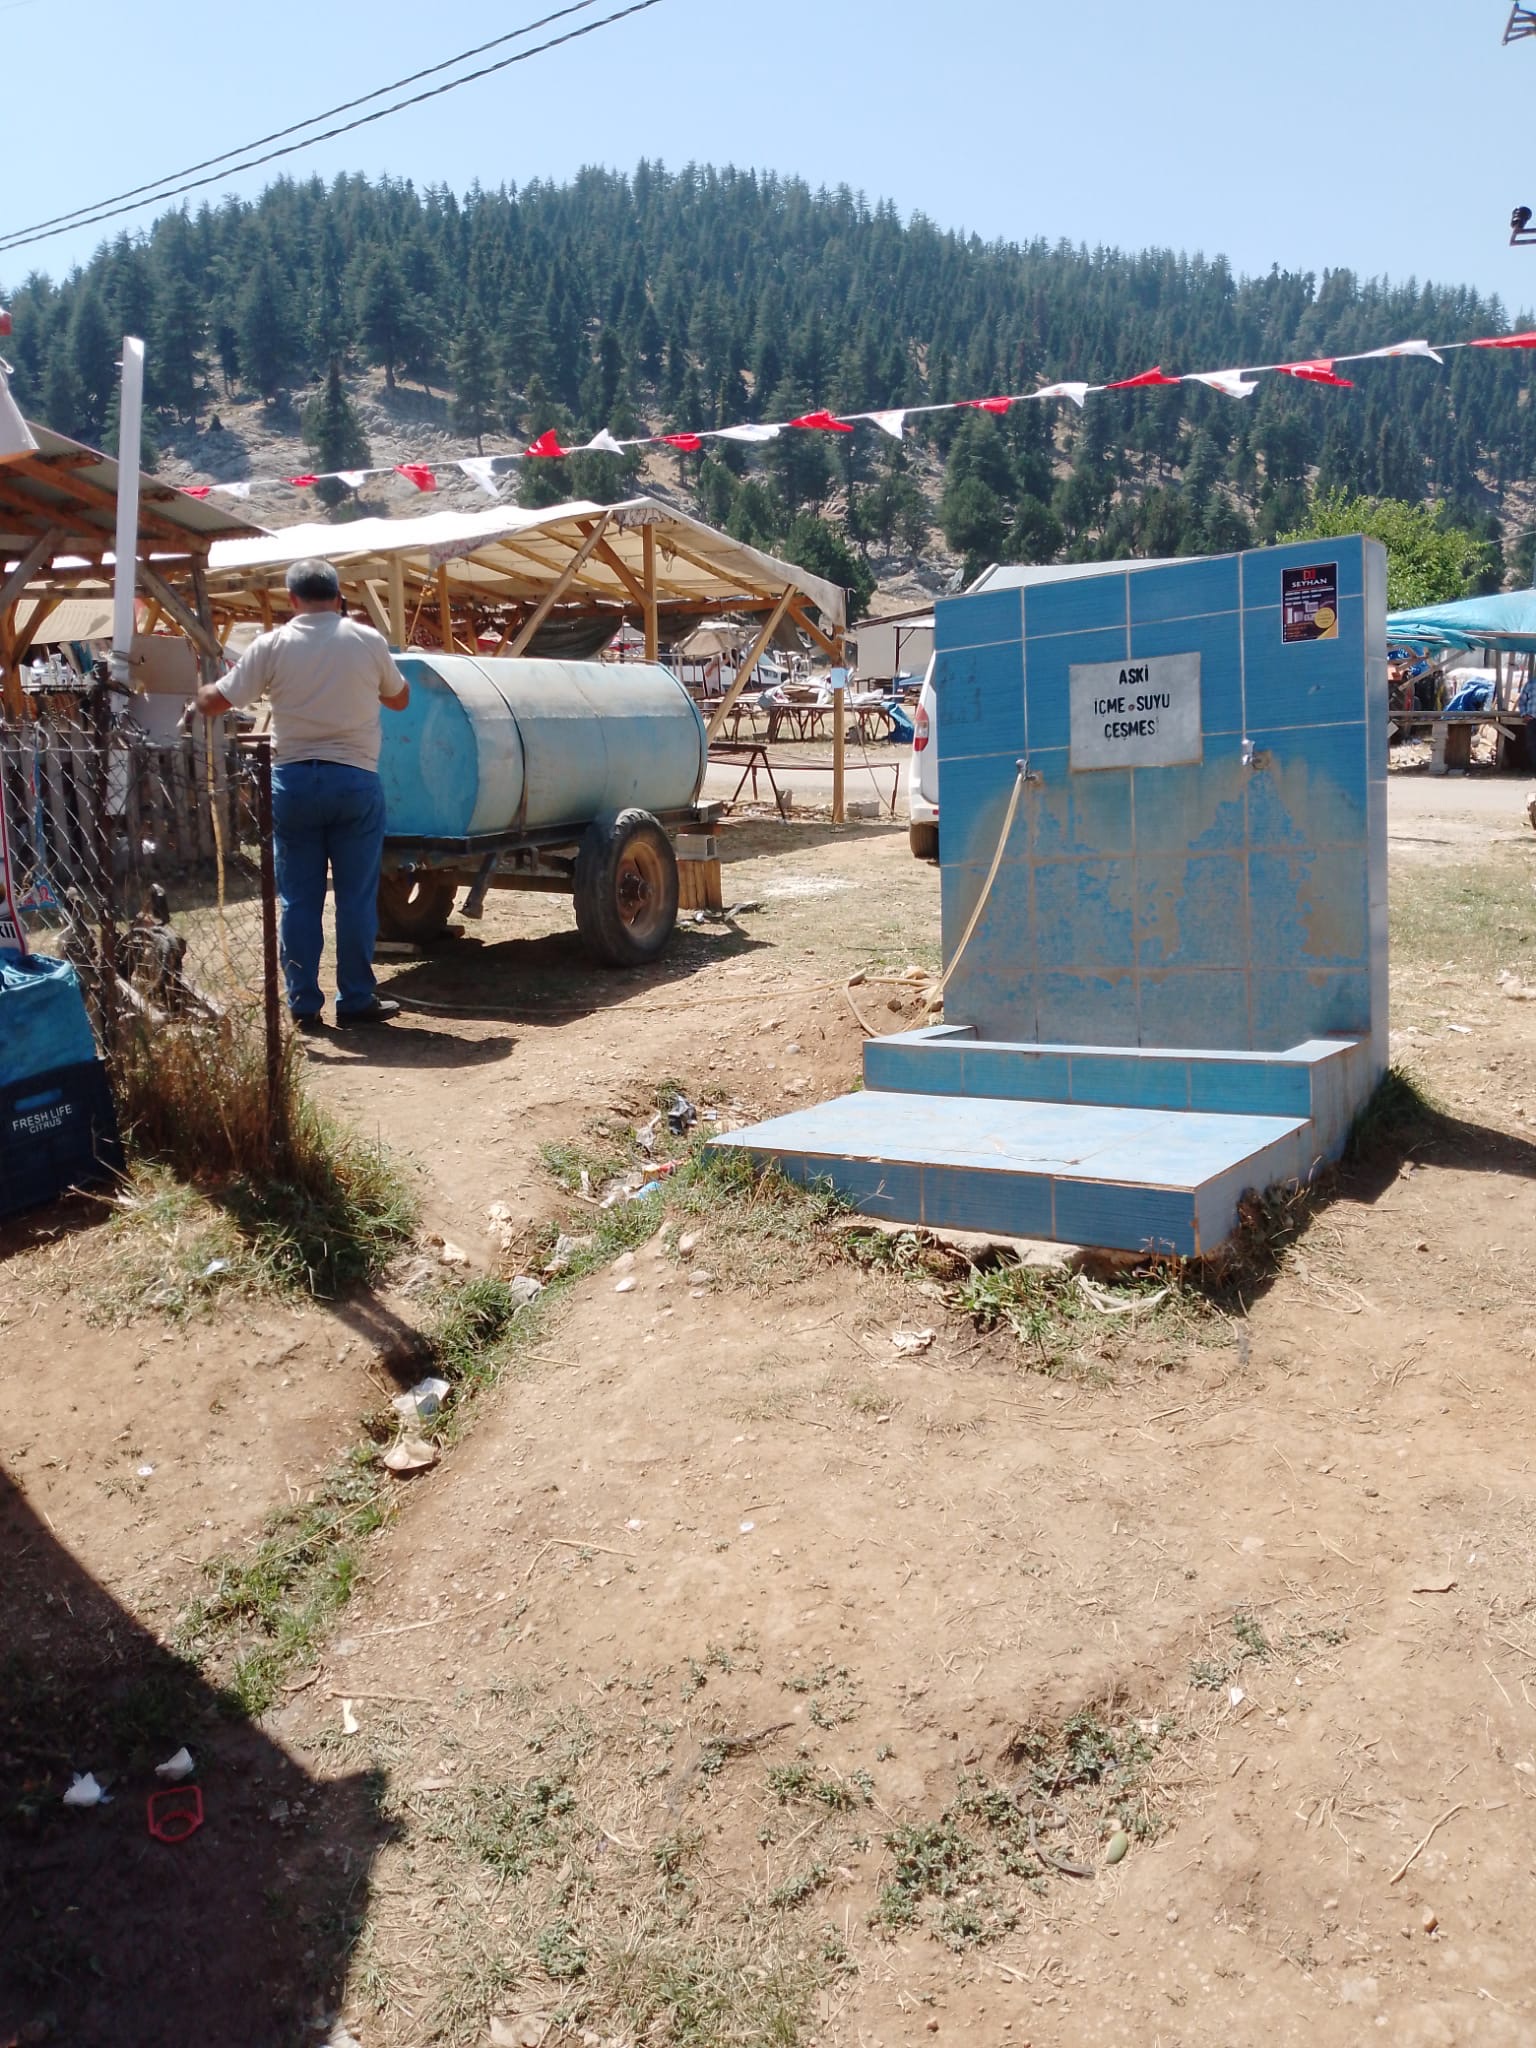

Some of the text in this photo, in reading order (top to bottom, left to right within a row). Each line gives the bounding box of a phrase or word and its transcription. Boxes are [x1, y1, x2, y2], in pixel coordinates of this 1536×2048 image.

[1291, 578, 1328, 588] SEYHAN
[1119, 664, 1149, 685] ASKİ
[1136, 693, 1171, 712] SUYU
[12, 1104, 73, 1132] FRESH LIFE
[29, 1118, 62, 1134] CITRUS
